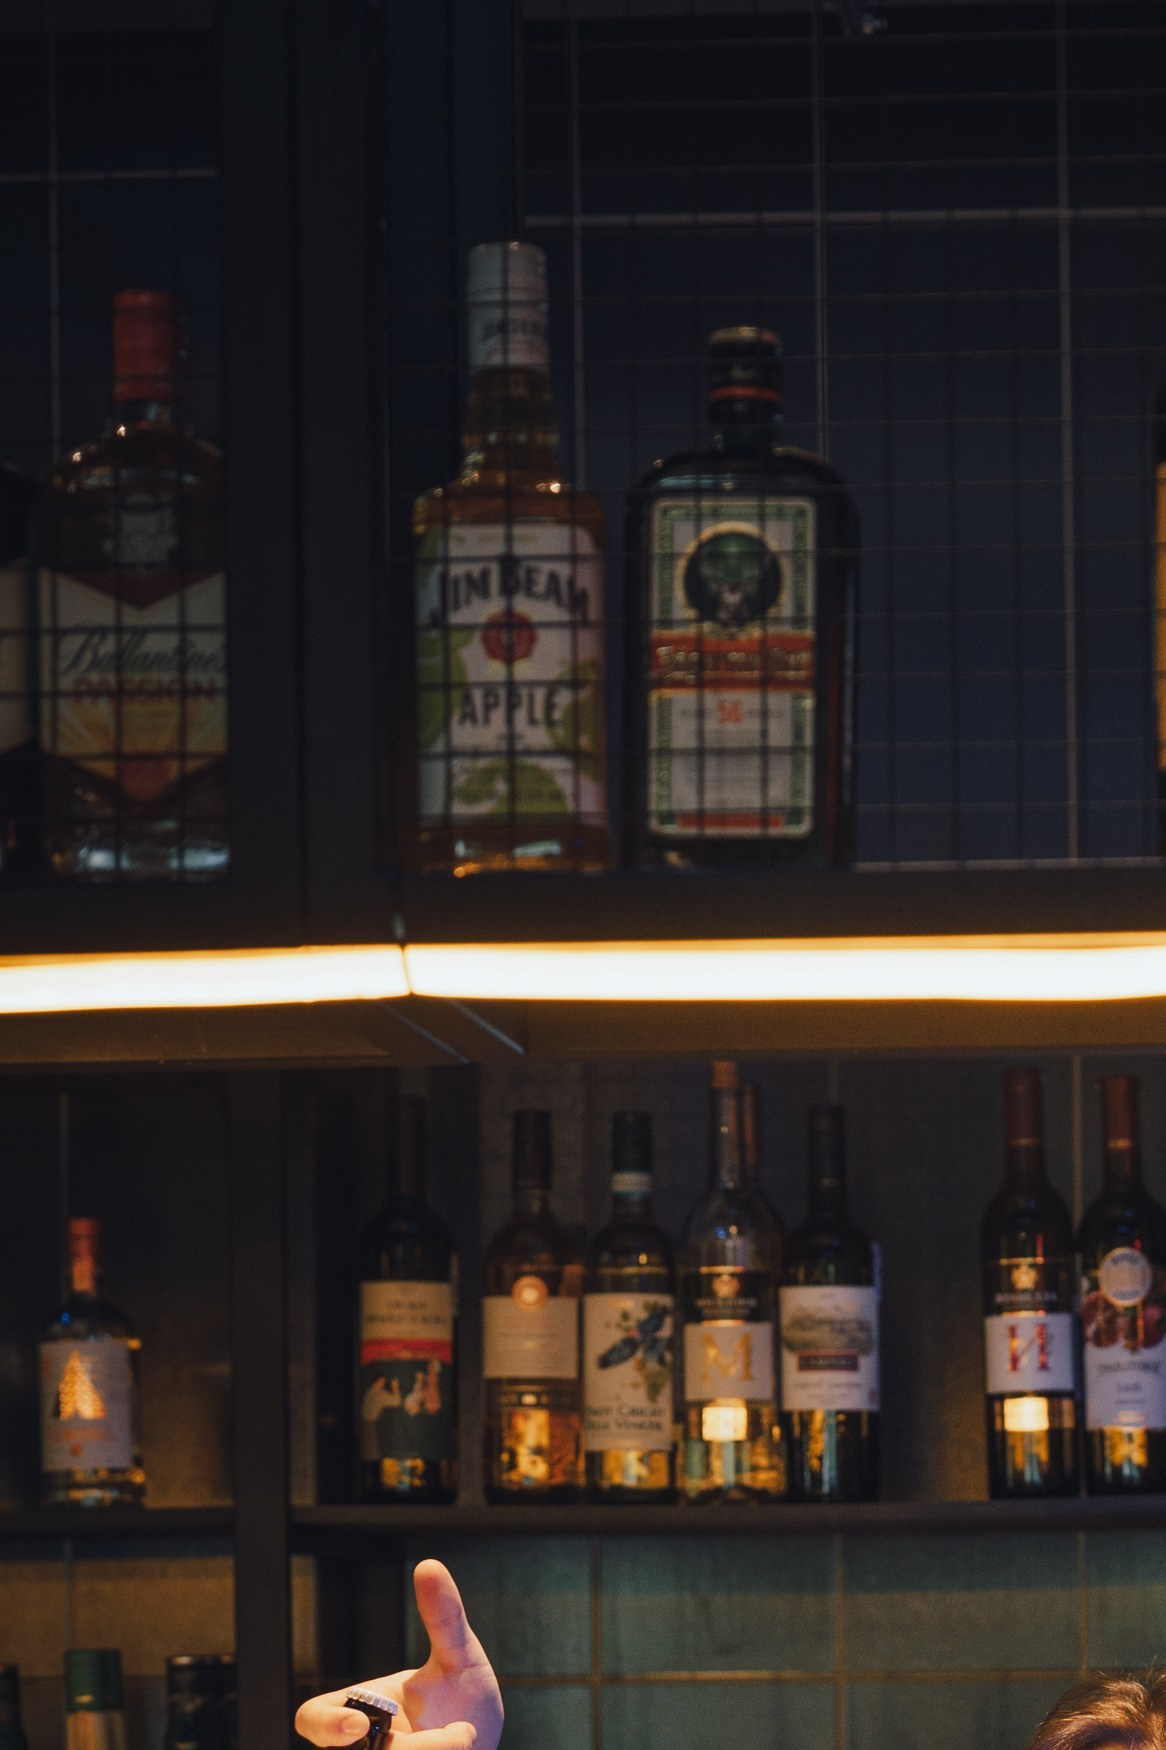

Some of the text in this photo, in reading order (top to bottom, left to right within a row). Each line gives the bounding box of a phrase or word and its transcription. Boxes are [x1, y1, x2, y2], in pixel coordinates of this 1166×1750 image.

[432, 556, 591, 630] JIM BEAM
[457, 688, 565, 732] APPLE
